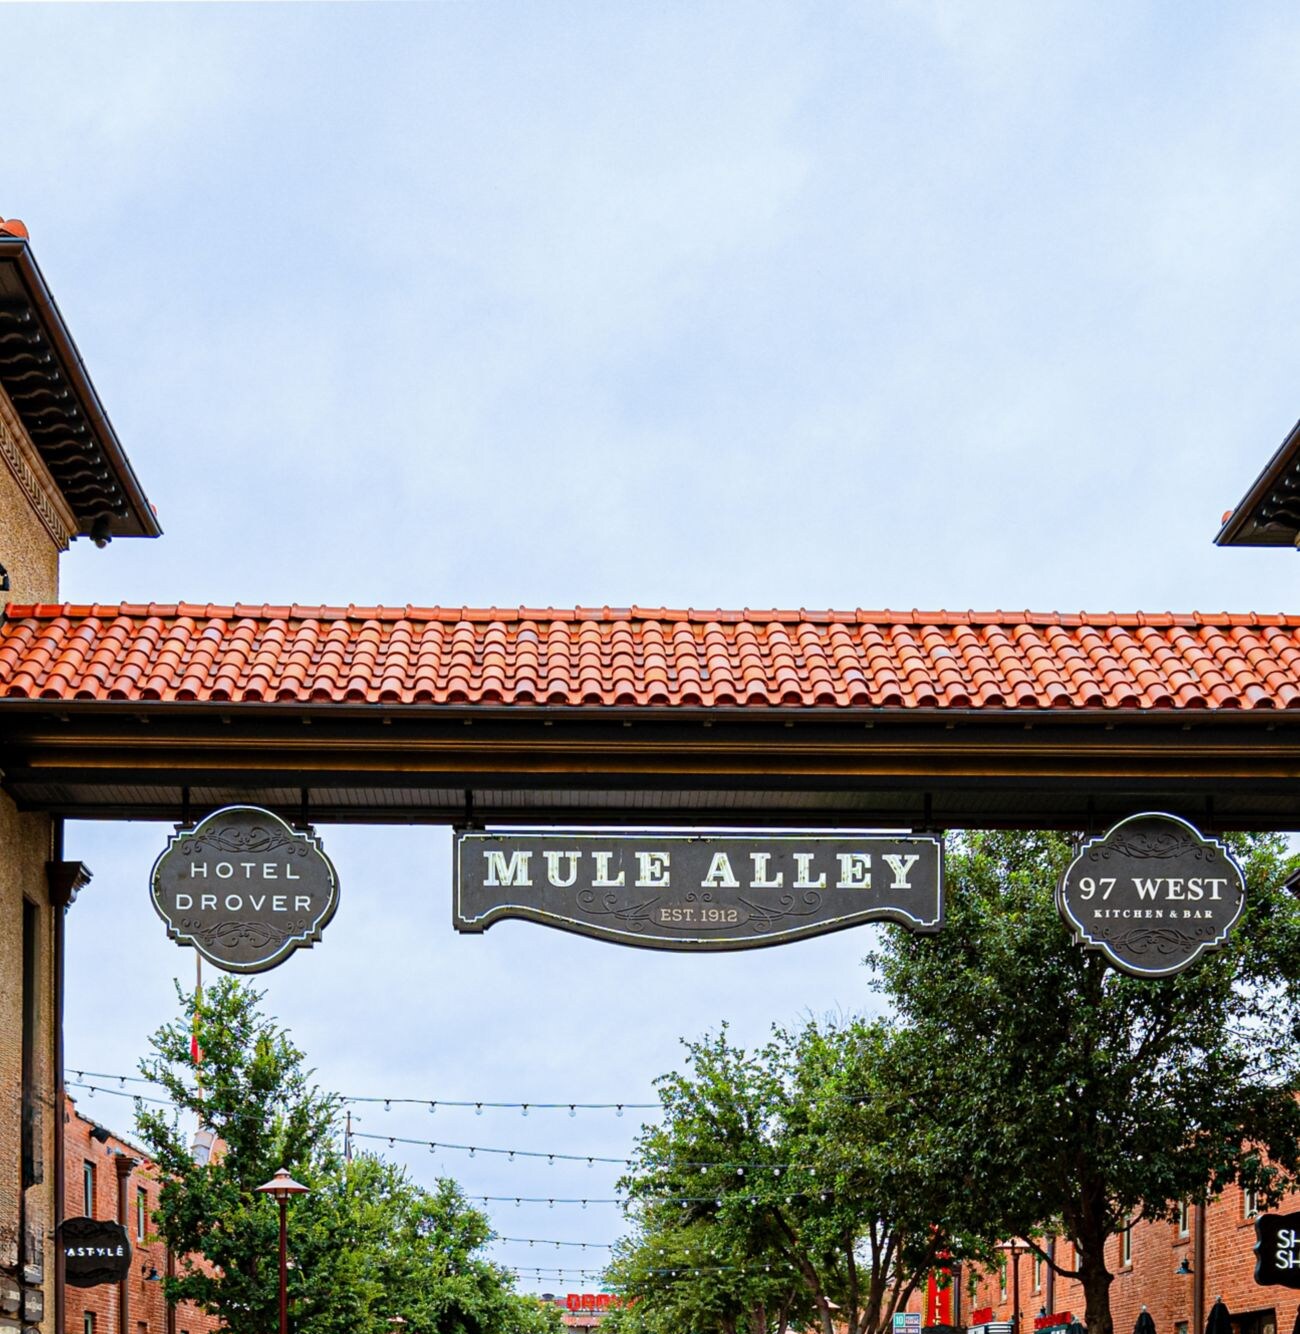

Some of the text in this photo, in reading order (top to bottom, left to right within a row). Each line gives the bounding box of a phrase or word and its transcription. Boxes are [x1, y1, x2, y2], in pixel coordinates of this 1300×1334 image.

[190, 862, 300, 879] HOTEL
[483, 851, 920, 889] MULE ALLEY
[1078, 877, 1228, 901] 97 WEST
[175, 894, 311, 911] DROVER
[660, 908, 738, 923] EST. 1912
[1094, 909, 1213, 919] KITCHEN & BAR
[895, 1316, 904, 1325] 10
